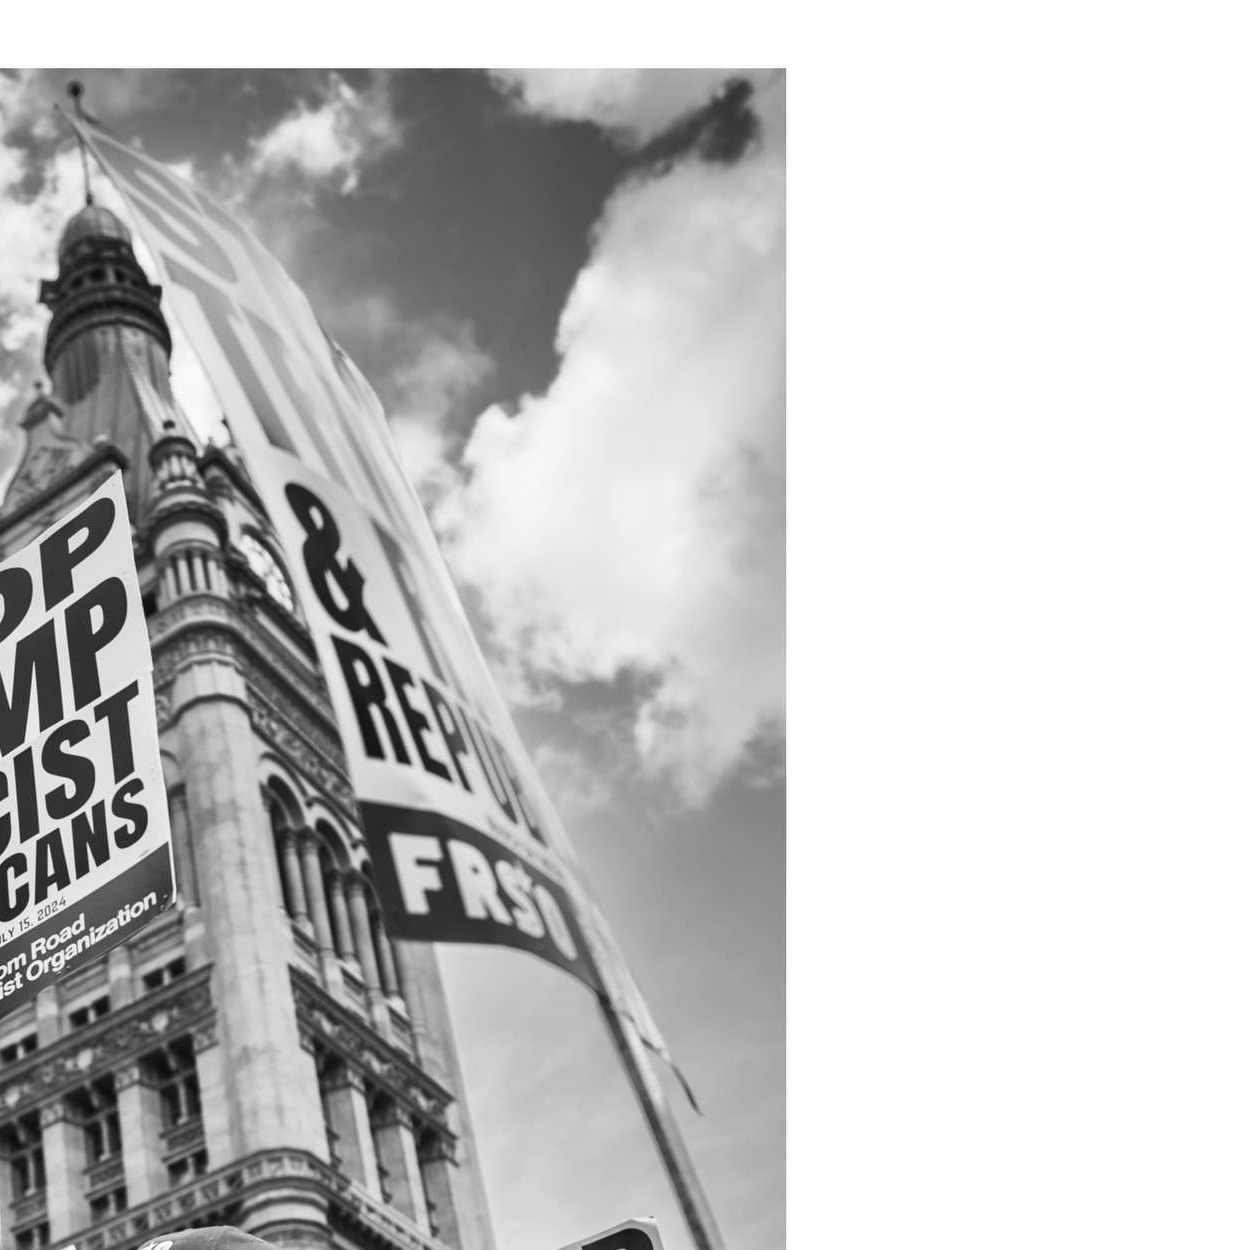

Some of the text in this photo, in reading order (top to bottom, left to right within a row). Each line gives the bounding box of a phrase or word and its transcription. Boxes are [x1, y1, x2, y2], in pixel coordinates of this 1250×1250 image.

[284, 481, 390, 649] &
[18, 917, 35, 933] 15,
[36, 896, 67, 923] 2024
[25, 891, 158, 983] Organization
[30, 912, 87, 961] Road
